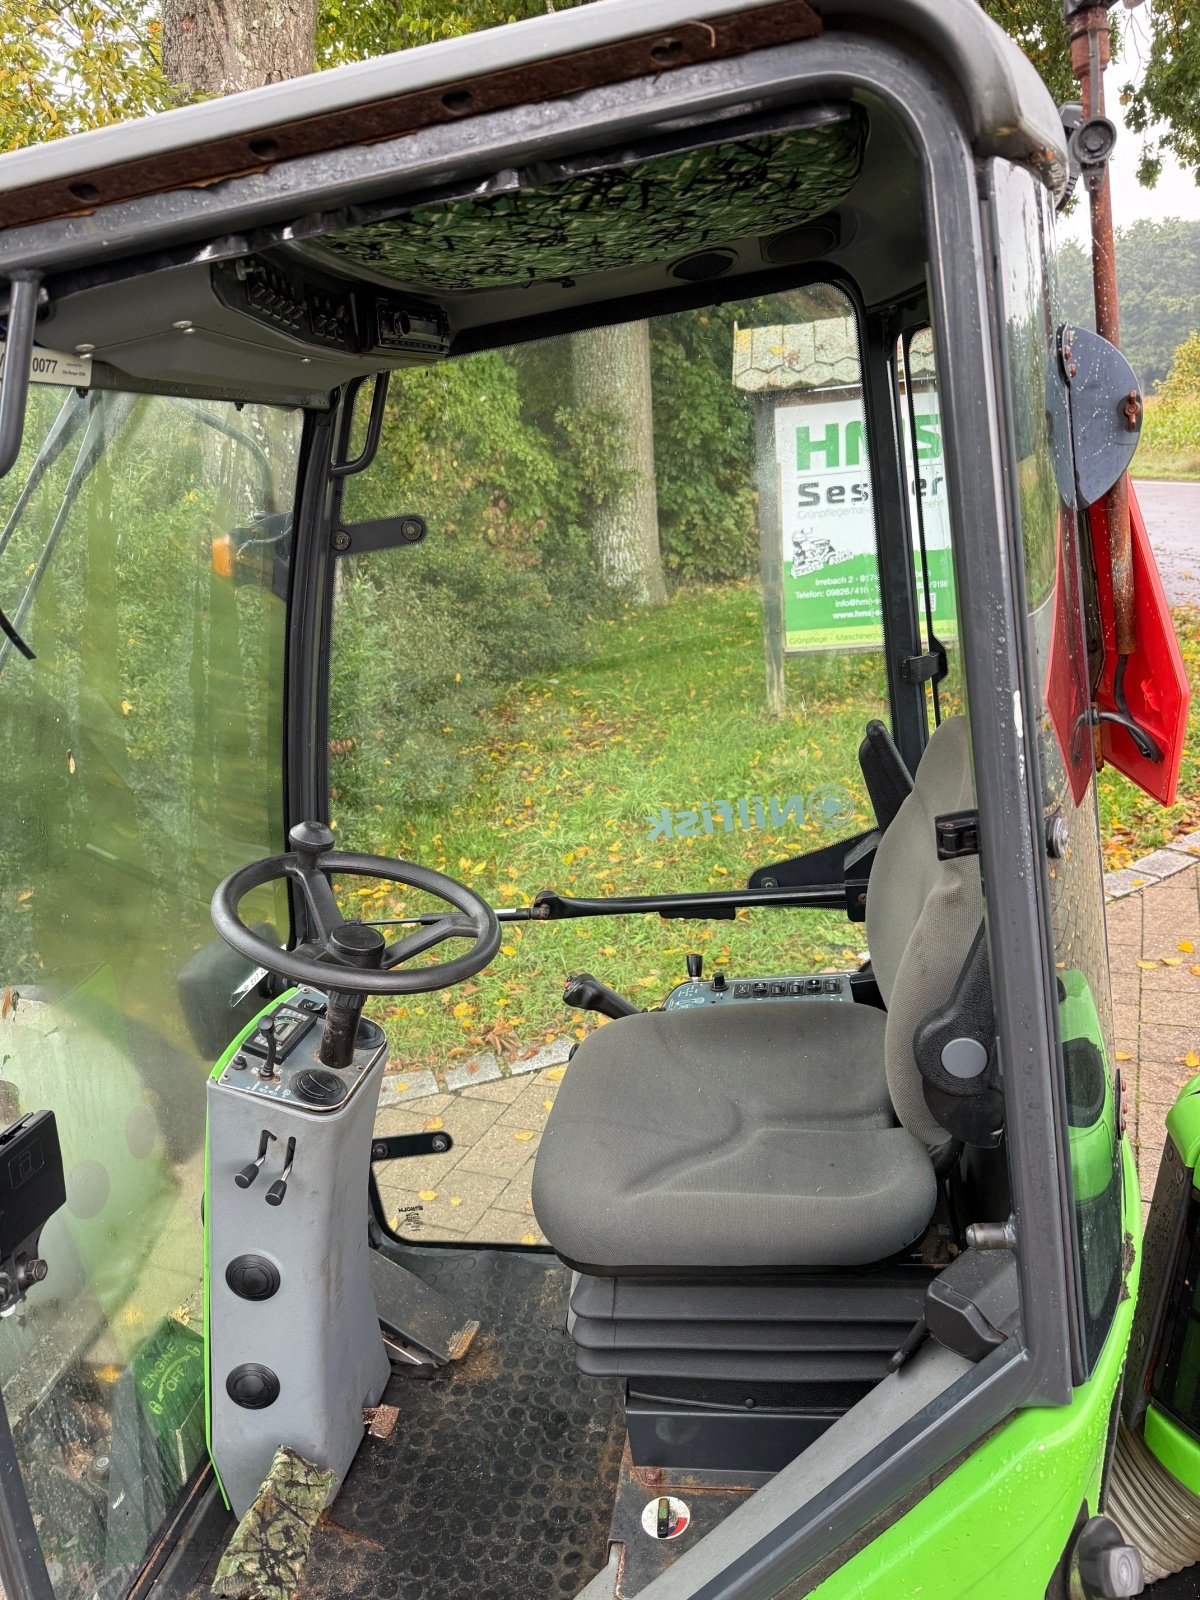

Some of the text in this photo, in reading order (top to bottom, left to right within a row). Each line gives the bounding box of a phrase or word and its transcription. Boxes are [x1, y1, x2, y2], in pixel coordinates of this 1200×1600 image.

[32, 357, 58, 374] 0077
[798, 477, 943, 507] Seser
[848, 575, 854, 584] 2
[142, 1343, 179, 1390] ENGINE
[165, 1366, 185, 1391] OFF
